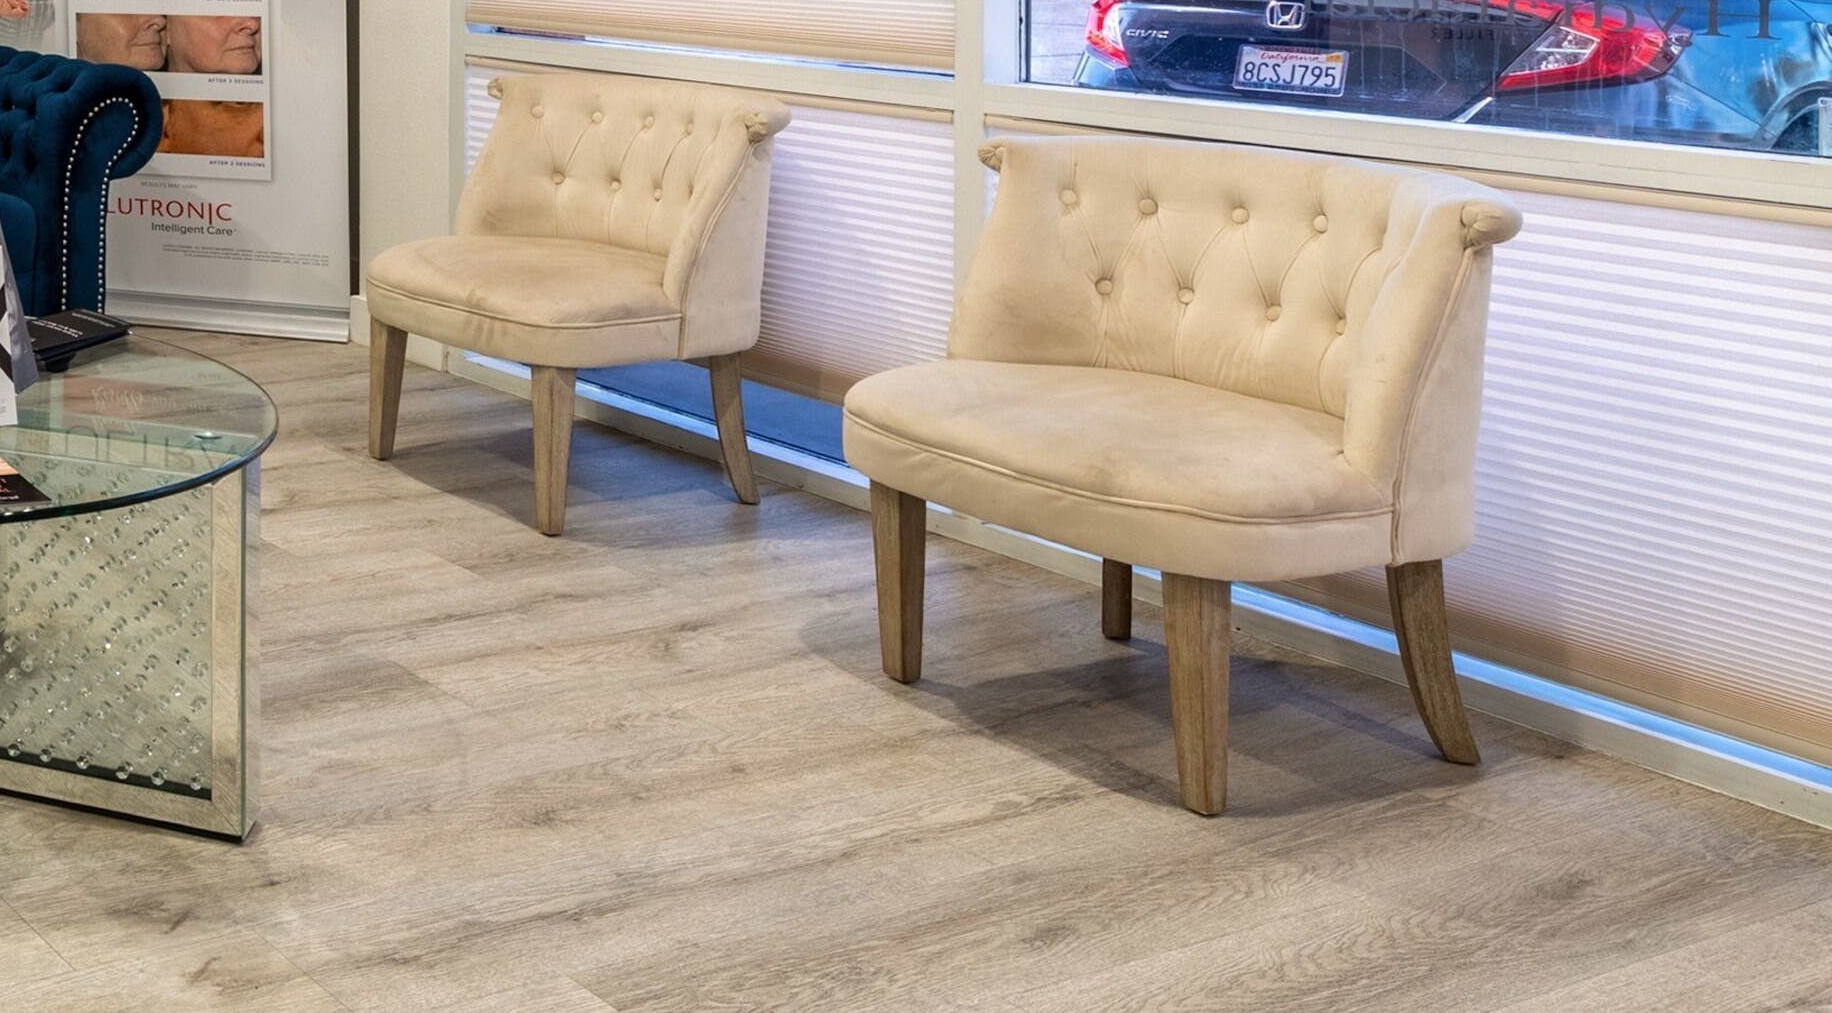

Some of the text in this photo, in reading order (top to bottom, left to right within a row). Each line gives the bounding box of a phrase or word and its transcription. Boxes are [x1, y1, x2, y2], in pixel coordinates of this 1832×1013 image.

[1126, 29, 1169, 39] CIVIC
[1261, 52, 1320, 63] California
[1243, 61, 1336, 87] 8CSJ795
[152, 222, 233, 236] Intelligent Care
